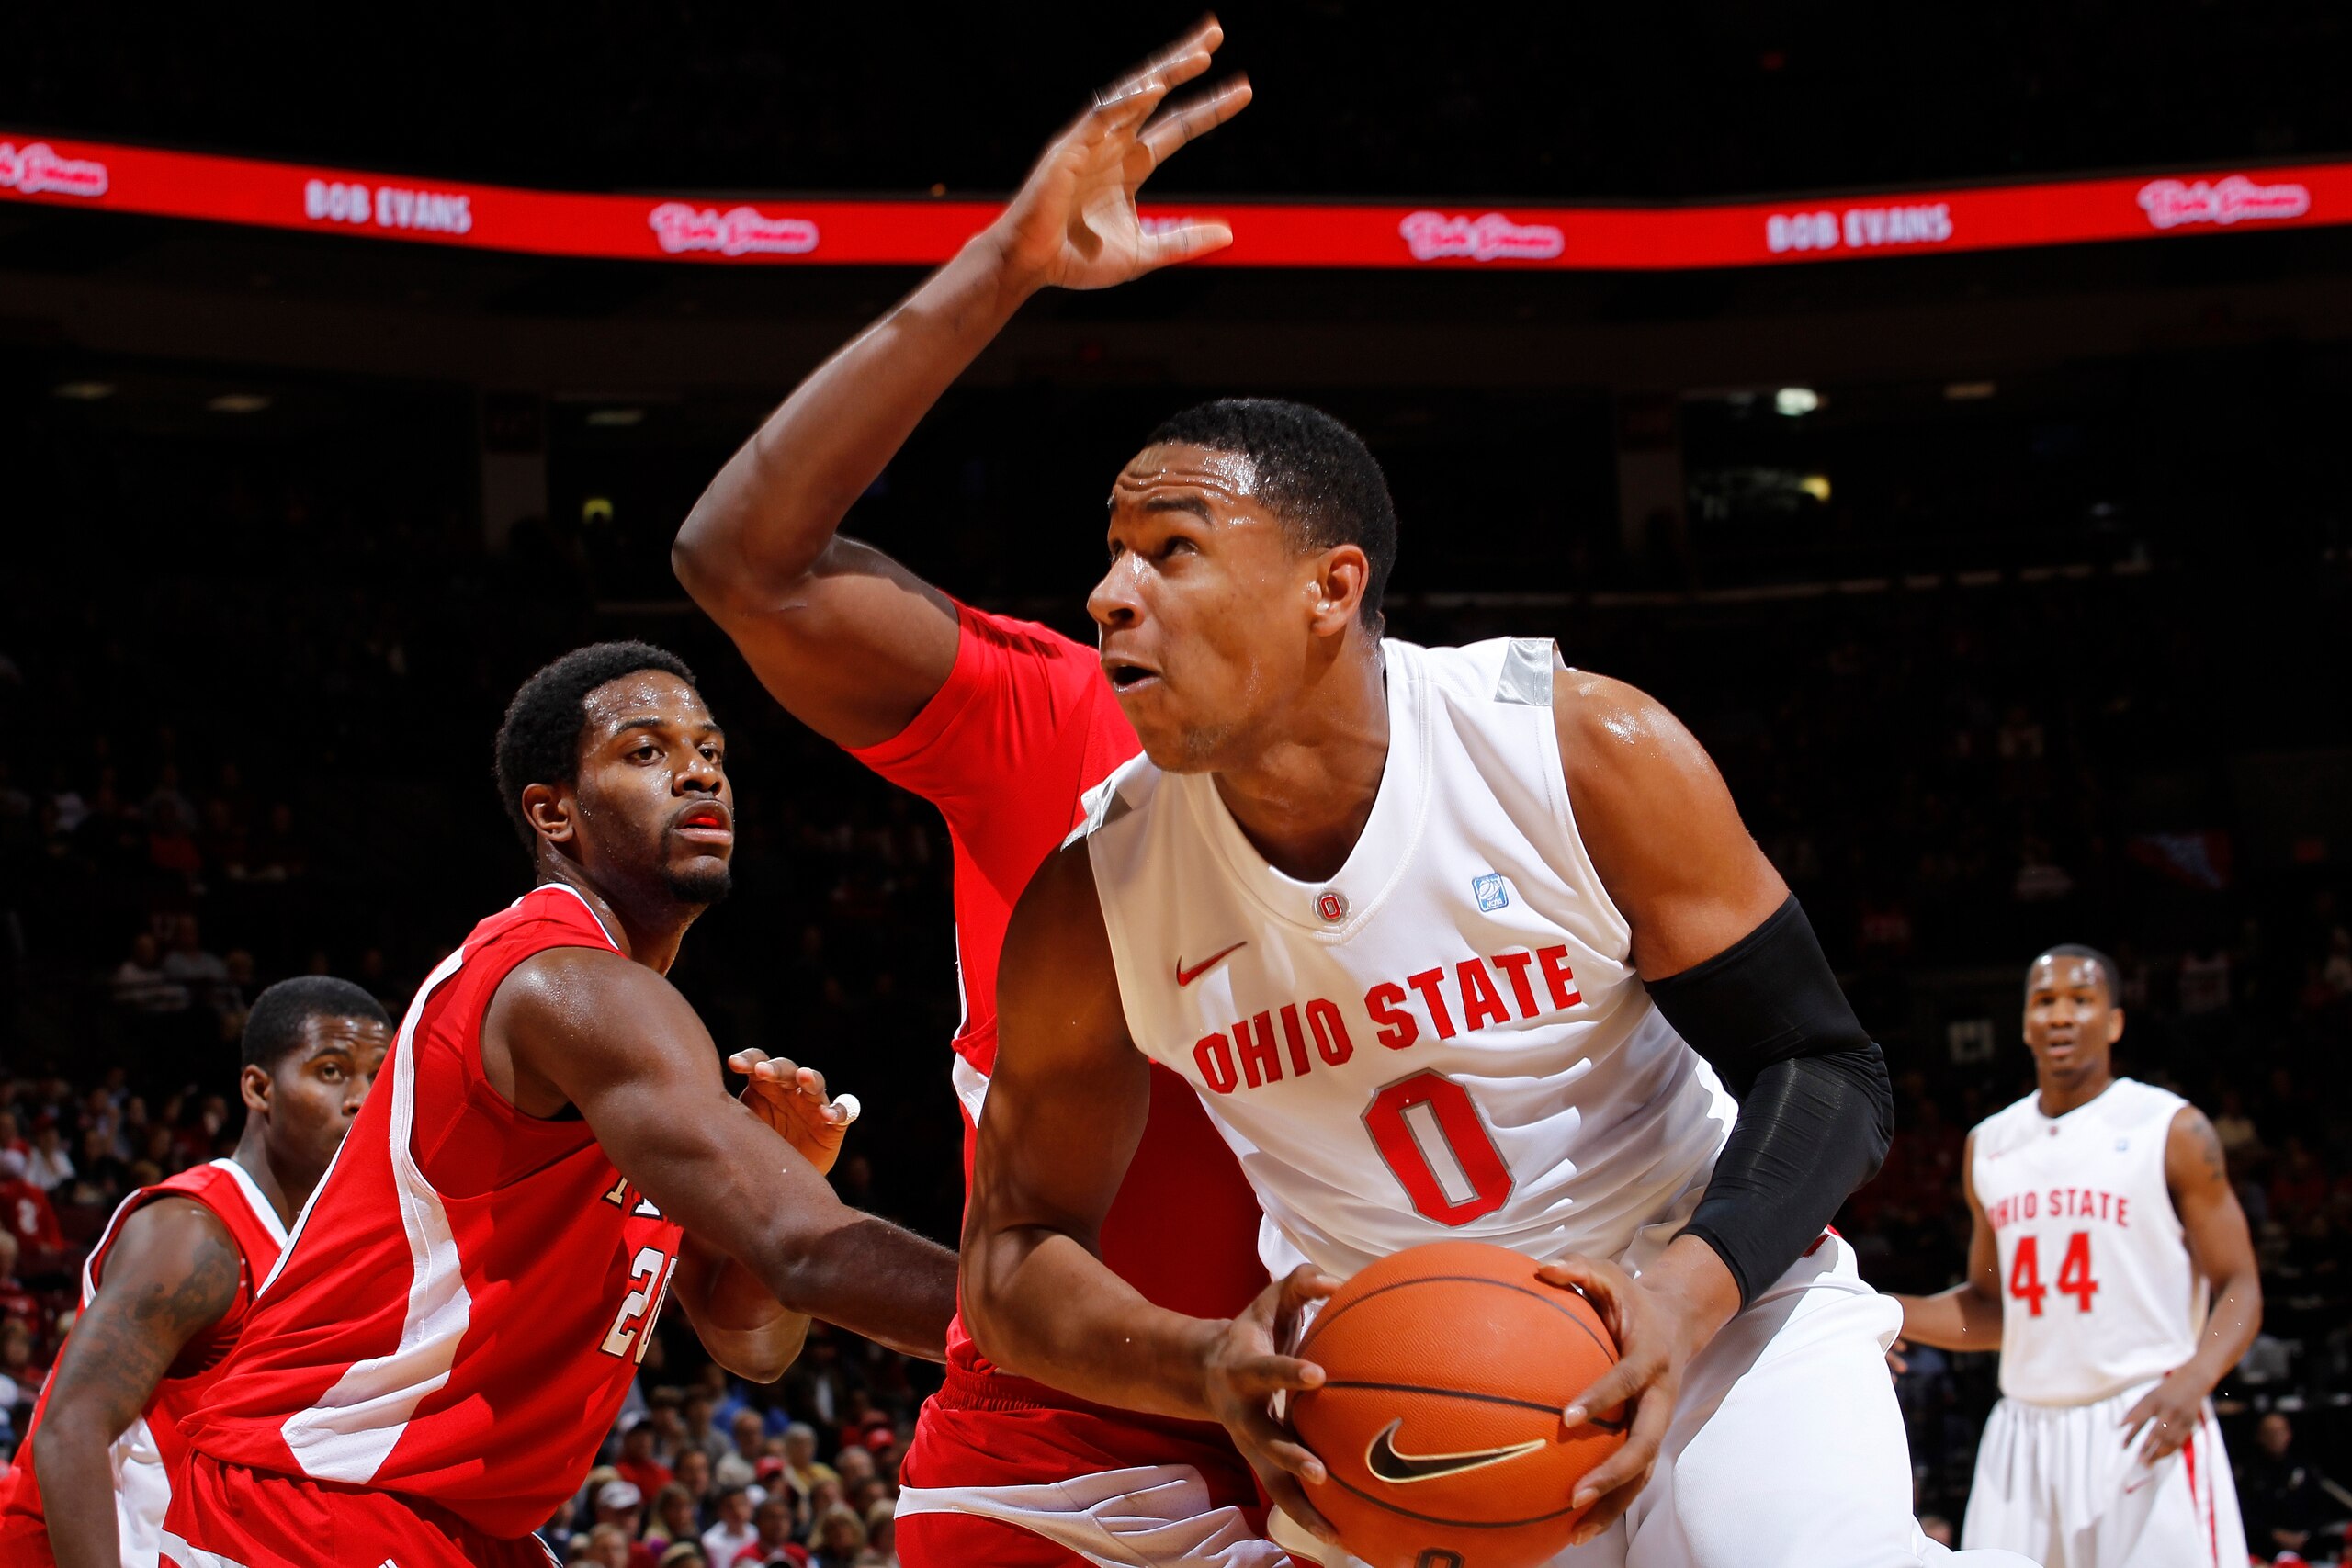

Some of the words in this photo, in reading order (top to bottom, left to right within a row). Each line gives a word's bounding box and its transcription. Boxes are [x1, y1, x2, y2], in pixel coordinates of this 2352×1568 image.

[305, 179, 371, 224] BOB
[375, 186, 472, 234] EVANS
[1766, 211, 1839, 253] BOB
[1843, 203, 1953, 247] EVANS
[1193, 998, 1353, 1094] OHIO
[1364, 944, 1582, 1051] STATE
[1360, 1067, 1517, 1229] 0
[2049, 1188, 2129, 1228] STATE
[2009, 1232, 2098, 1317] 44
